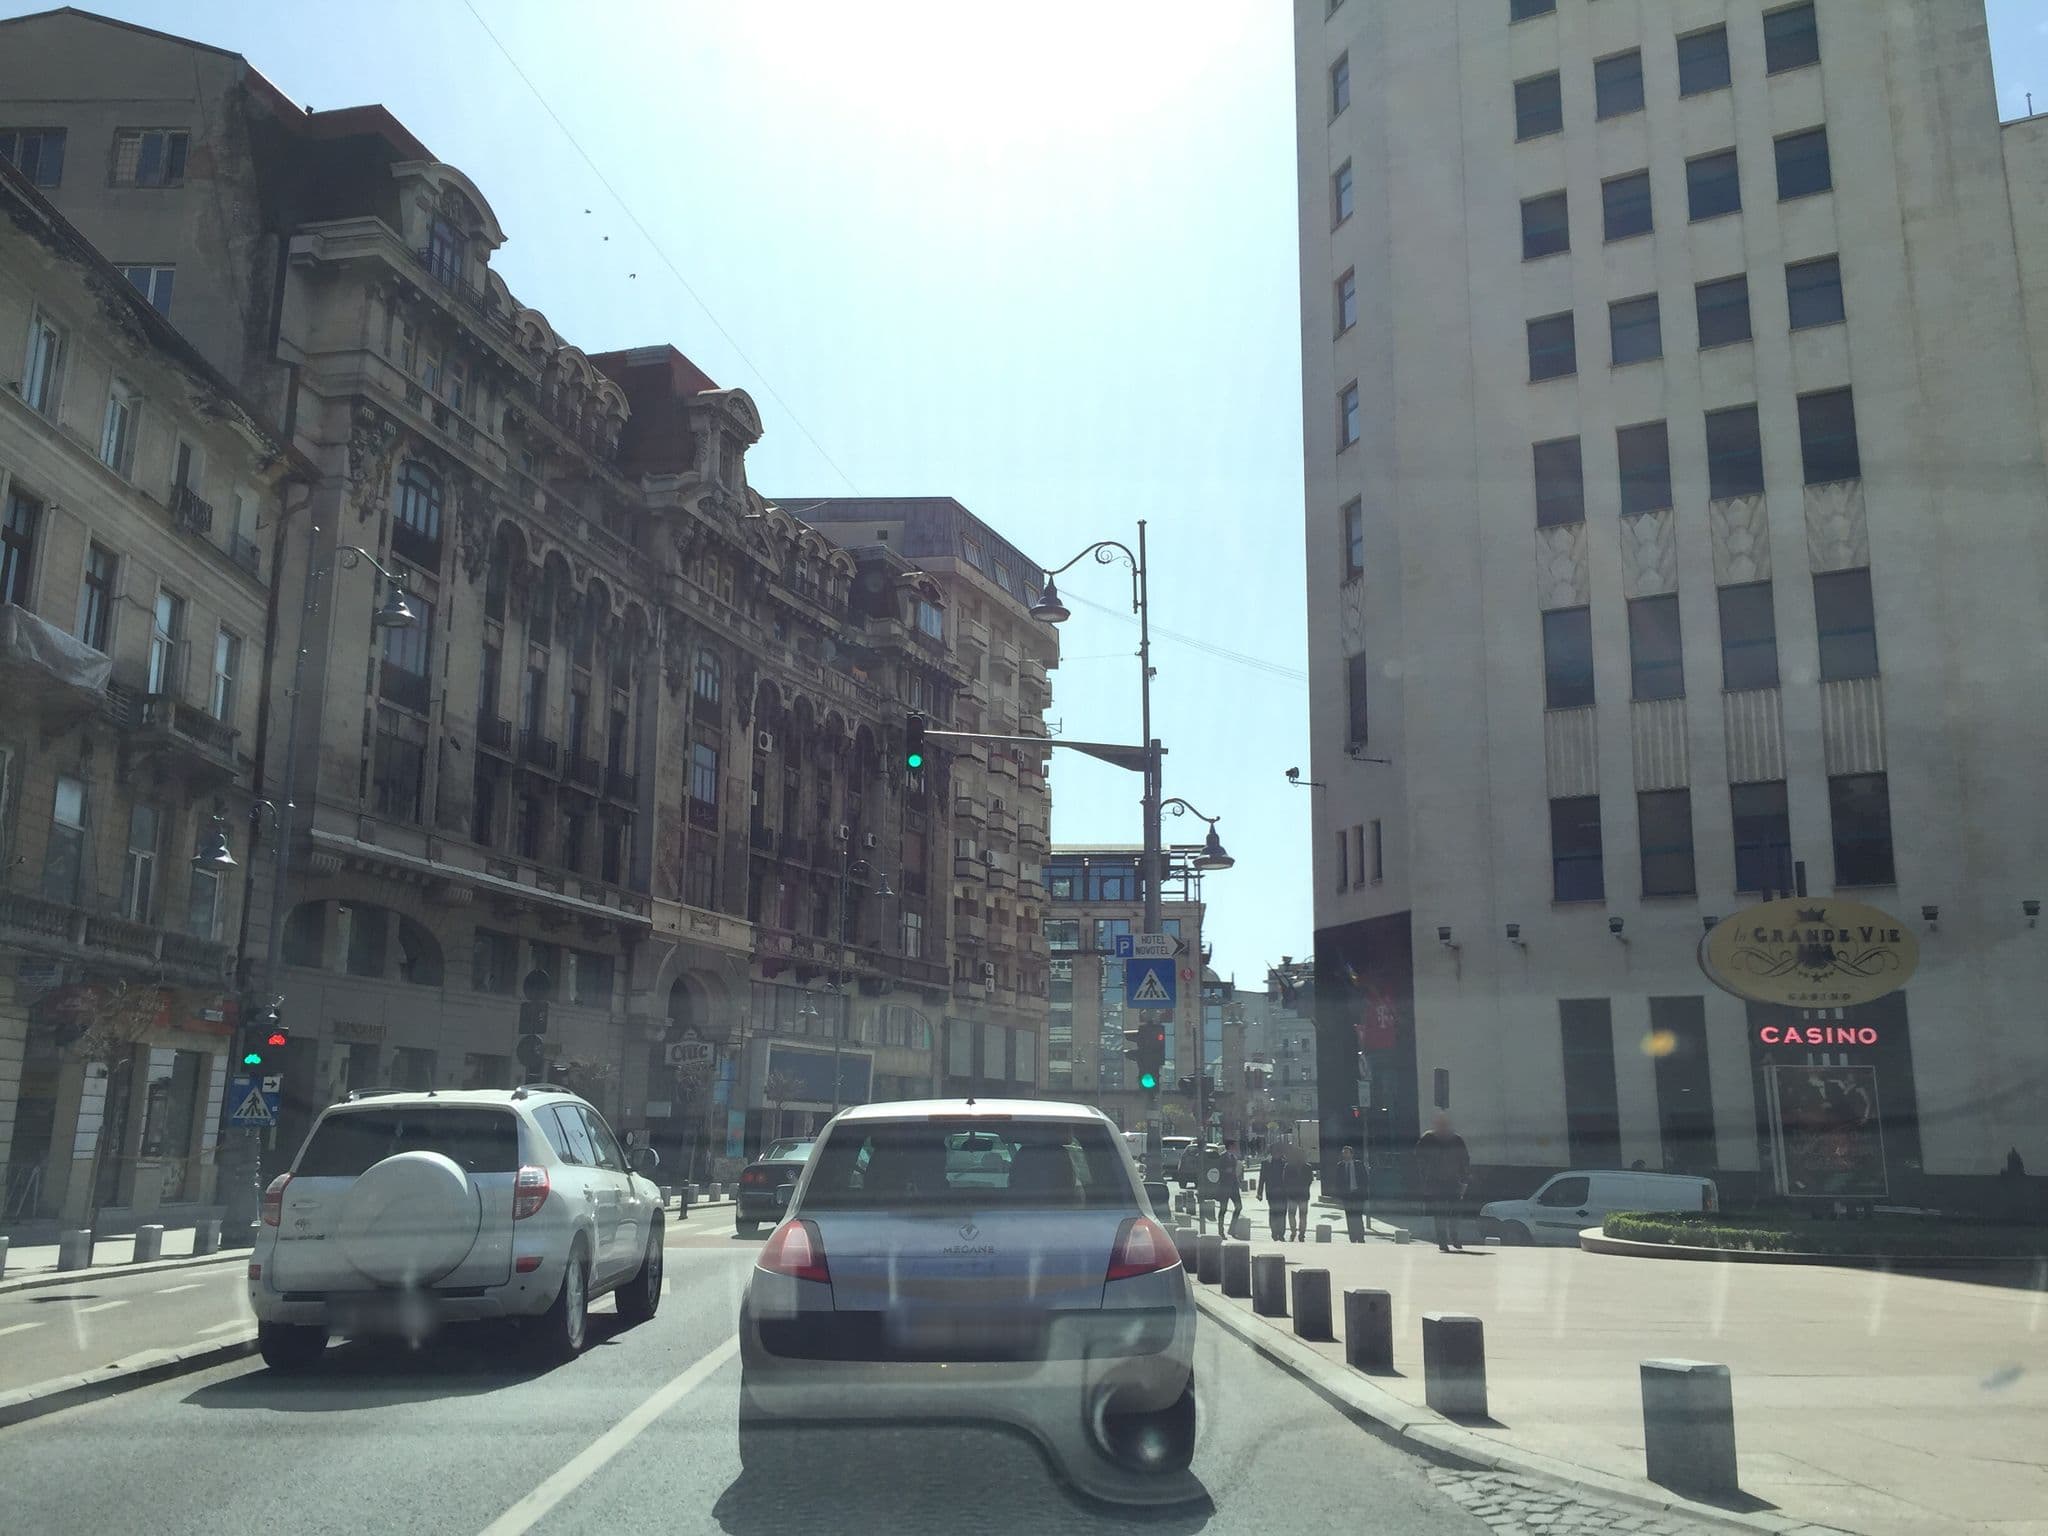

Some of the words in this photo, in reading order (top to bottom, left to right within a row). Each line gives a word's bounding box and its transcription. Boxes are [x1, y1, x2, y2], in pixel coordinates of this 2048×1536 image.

[1753, 926, 1850, 943] GRANDE
[1858, 926, 1901, 943] VIE
[1141, 935, 1166, 945] HOTEL
[1120, 941, 1130, 954] P
[1135, 946, 1170, 955] NOVOTEL
[1788, 992, 1852, 1001] CASINO
[1759, 1026, 1878, 1045] CASINO
[942, 1245, 995, 1254] MEGANE
